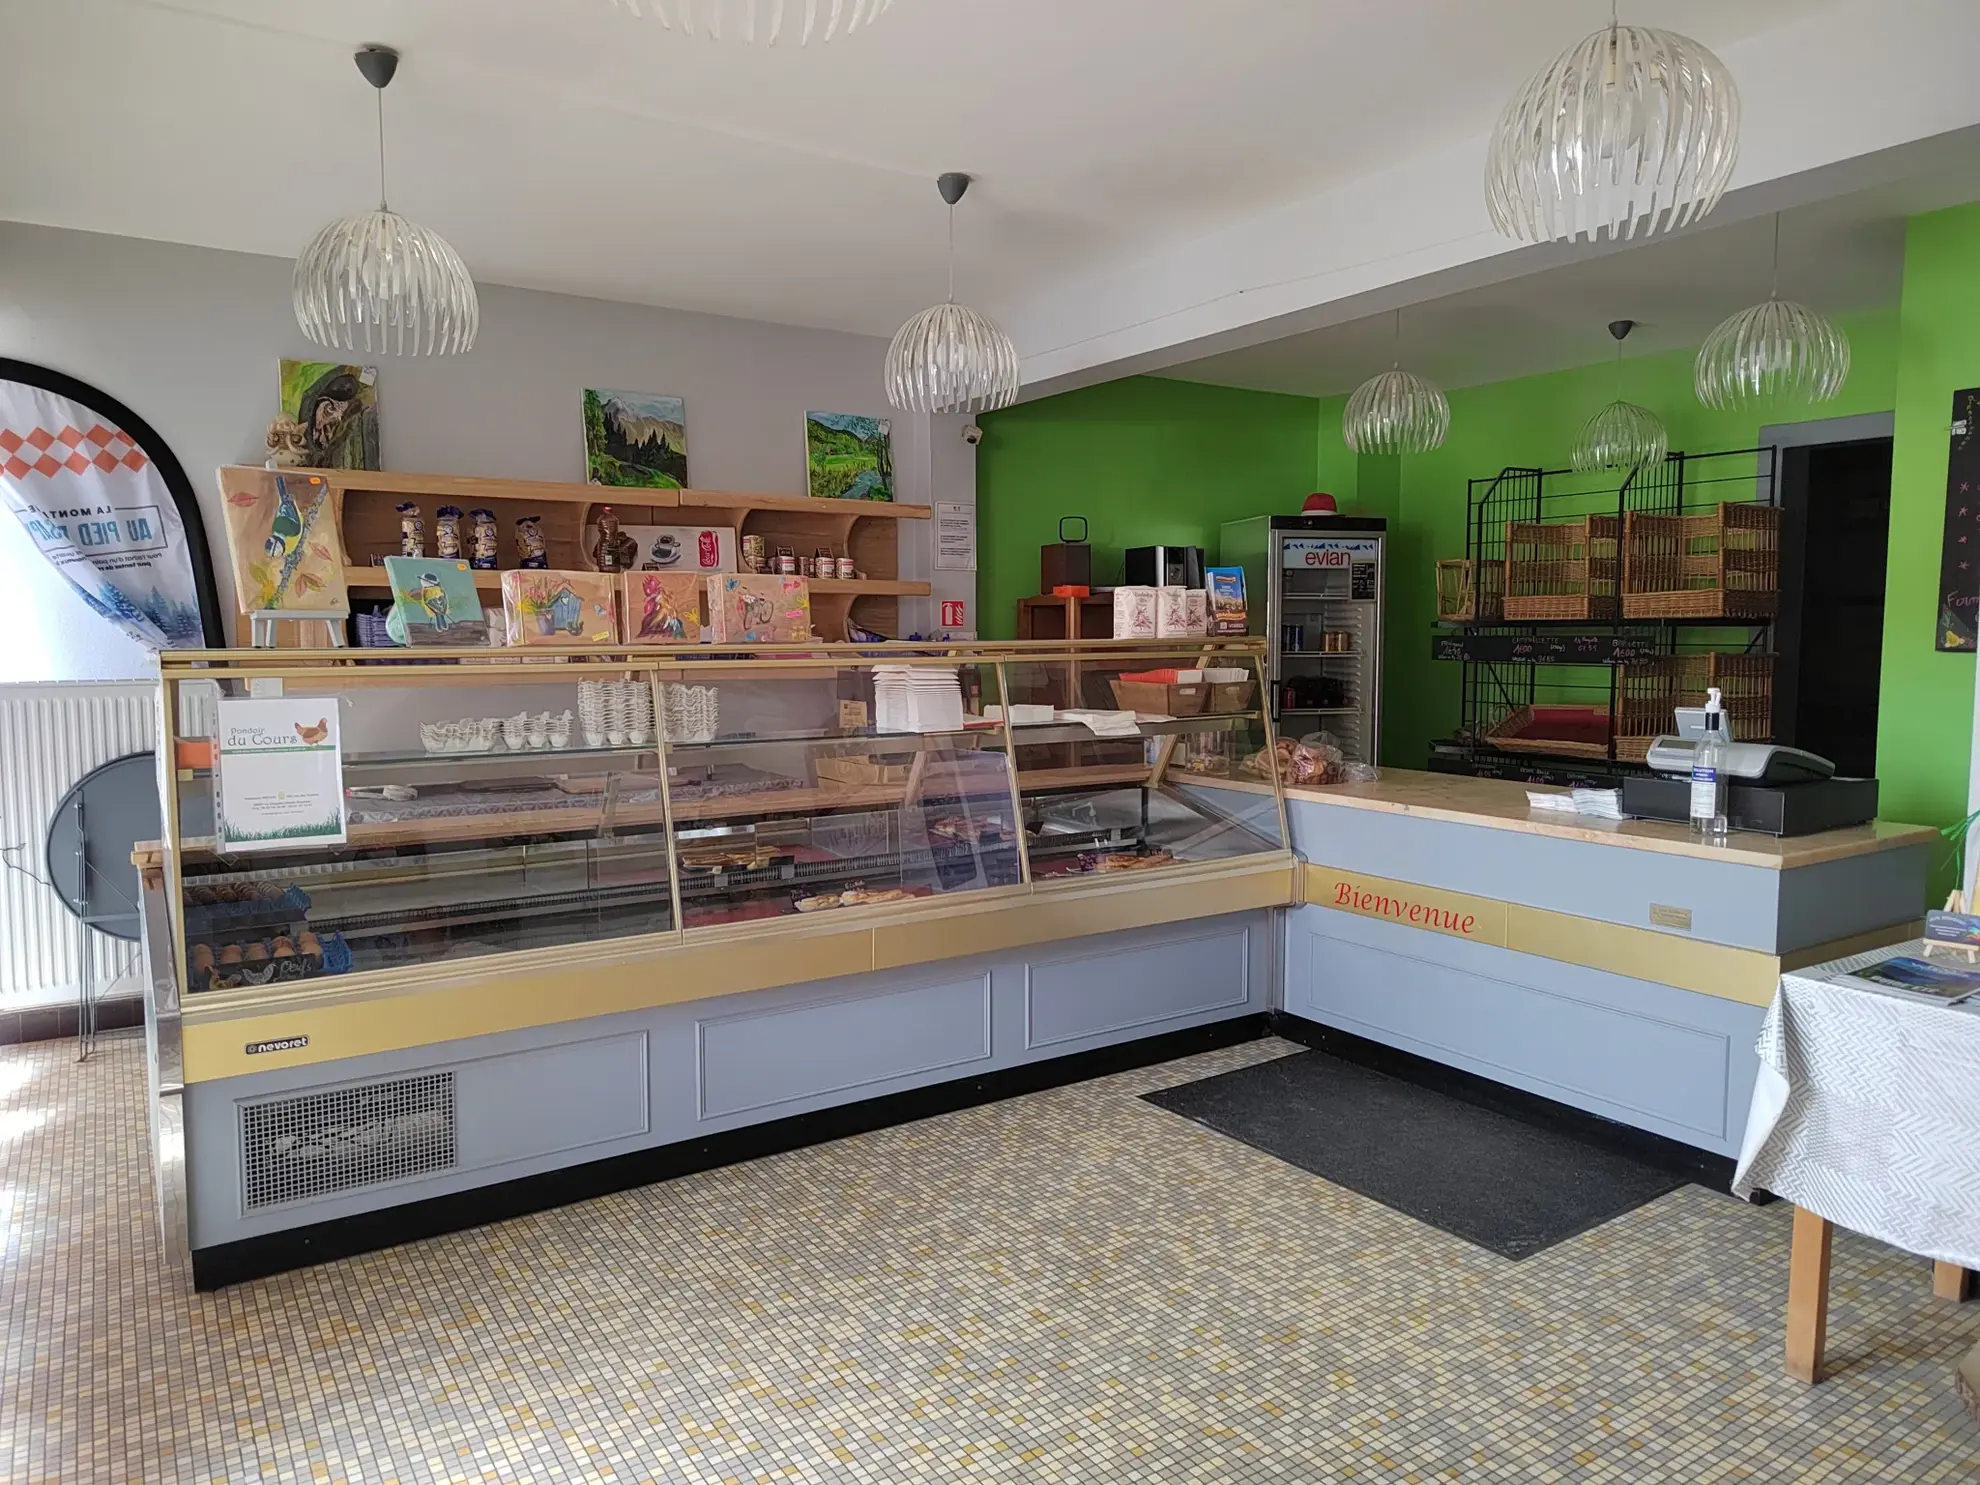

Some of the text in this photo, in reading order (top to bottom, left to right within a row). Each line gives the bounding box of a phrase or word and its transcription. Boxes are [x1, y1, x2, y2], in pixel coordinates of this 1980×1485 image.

[1305, 549, 1351, 566] evian
[227, 733, 298, 746] du Cours
[1334, 881, 1475, 934] Bienvenue
[257, 1036, 308, 1053] nevoret
